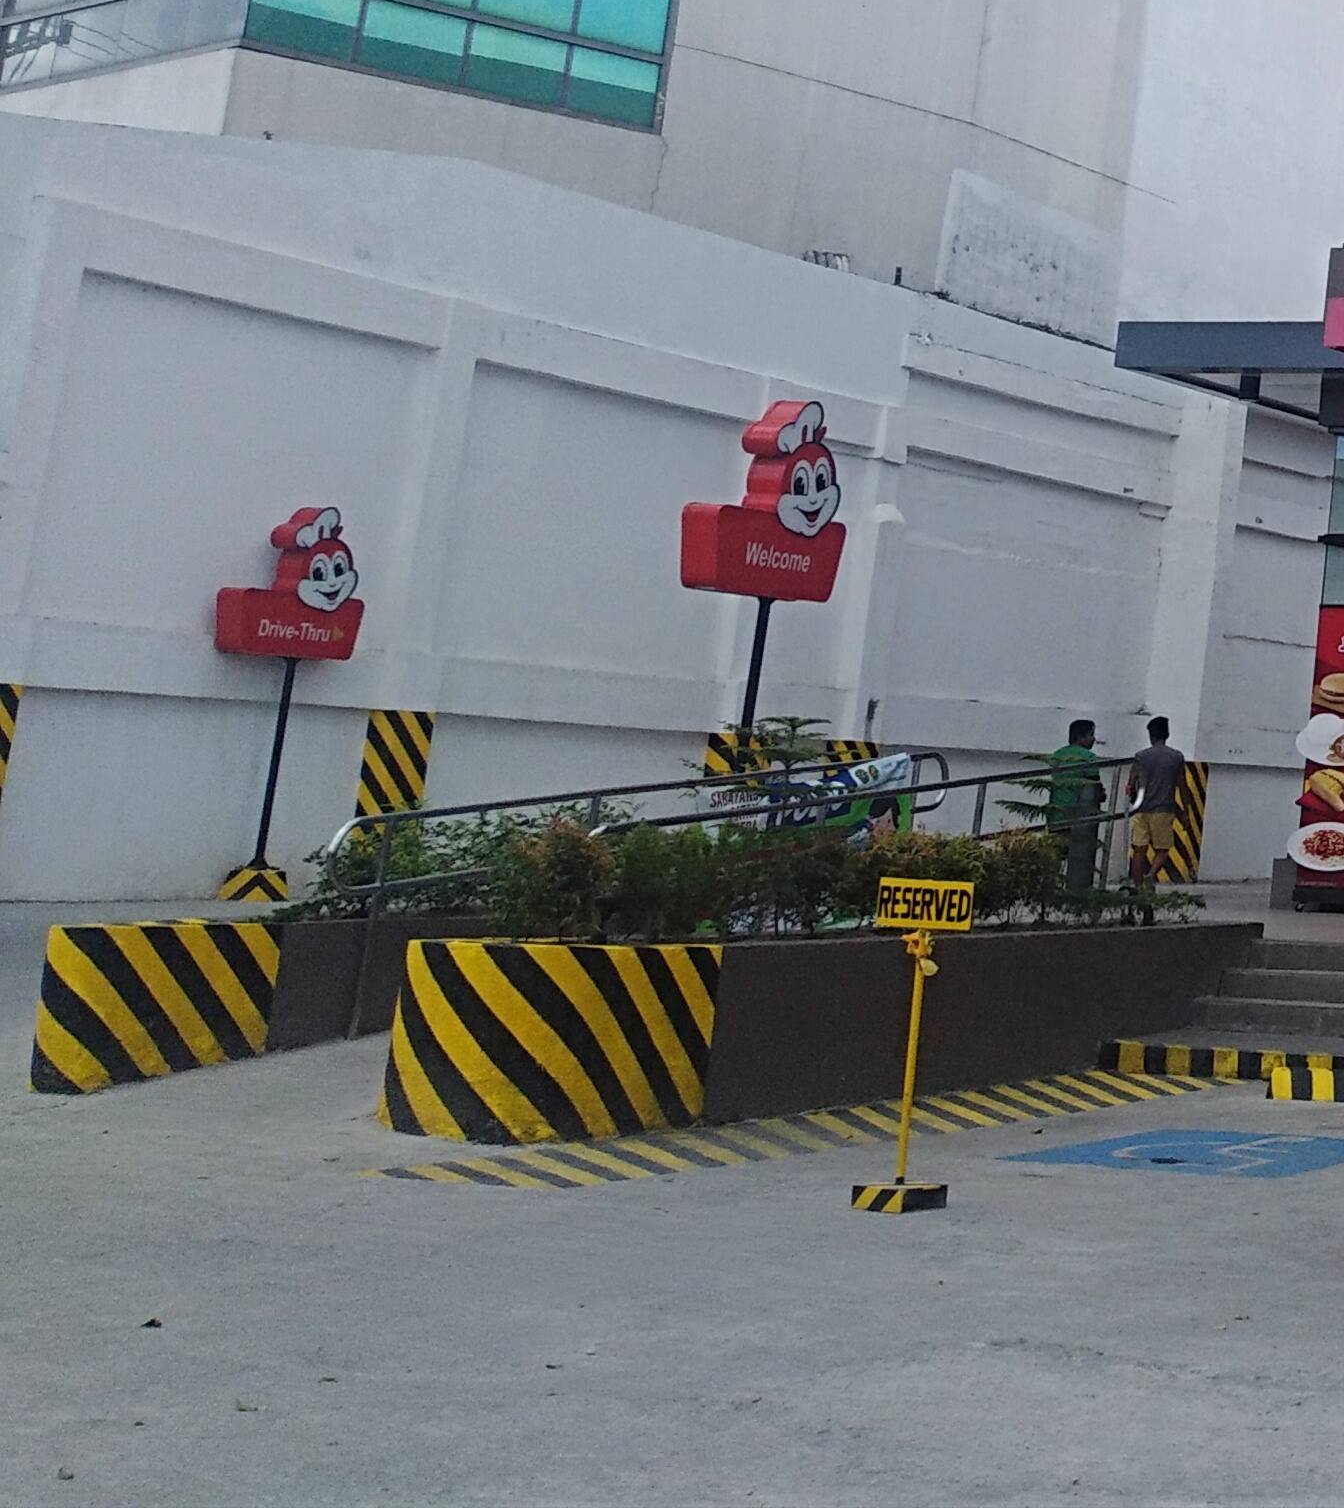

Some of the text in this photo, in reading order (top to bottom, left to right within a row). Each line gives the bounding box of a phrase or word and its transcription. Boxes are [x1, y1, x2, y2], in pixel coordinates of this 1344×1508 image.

[745, 542, 812, 573] Welcome
[258, 619, 330, 642] Drive-Thru
[878, 885, 971, 923] RESERVED
